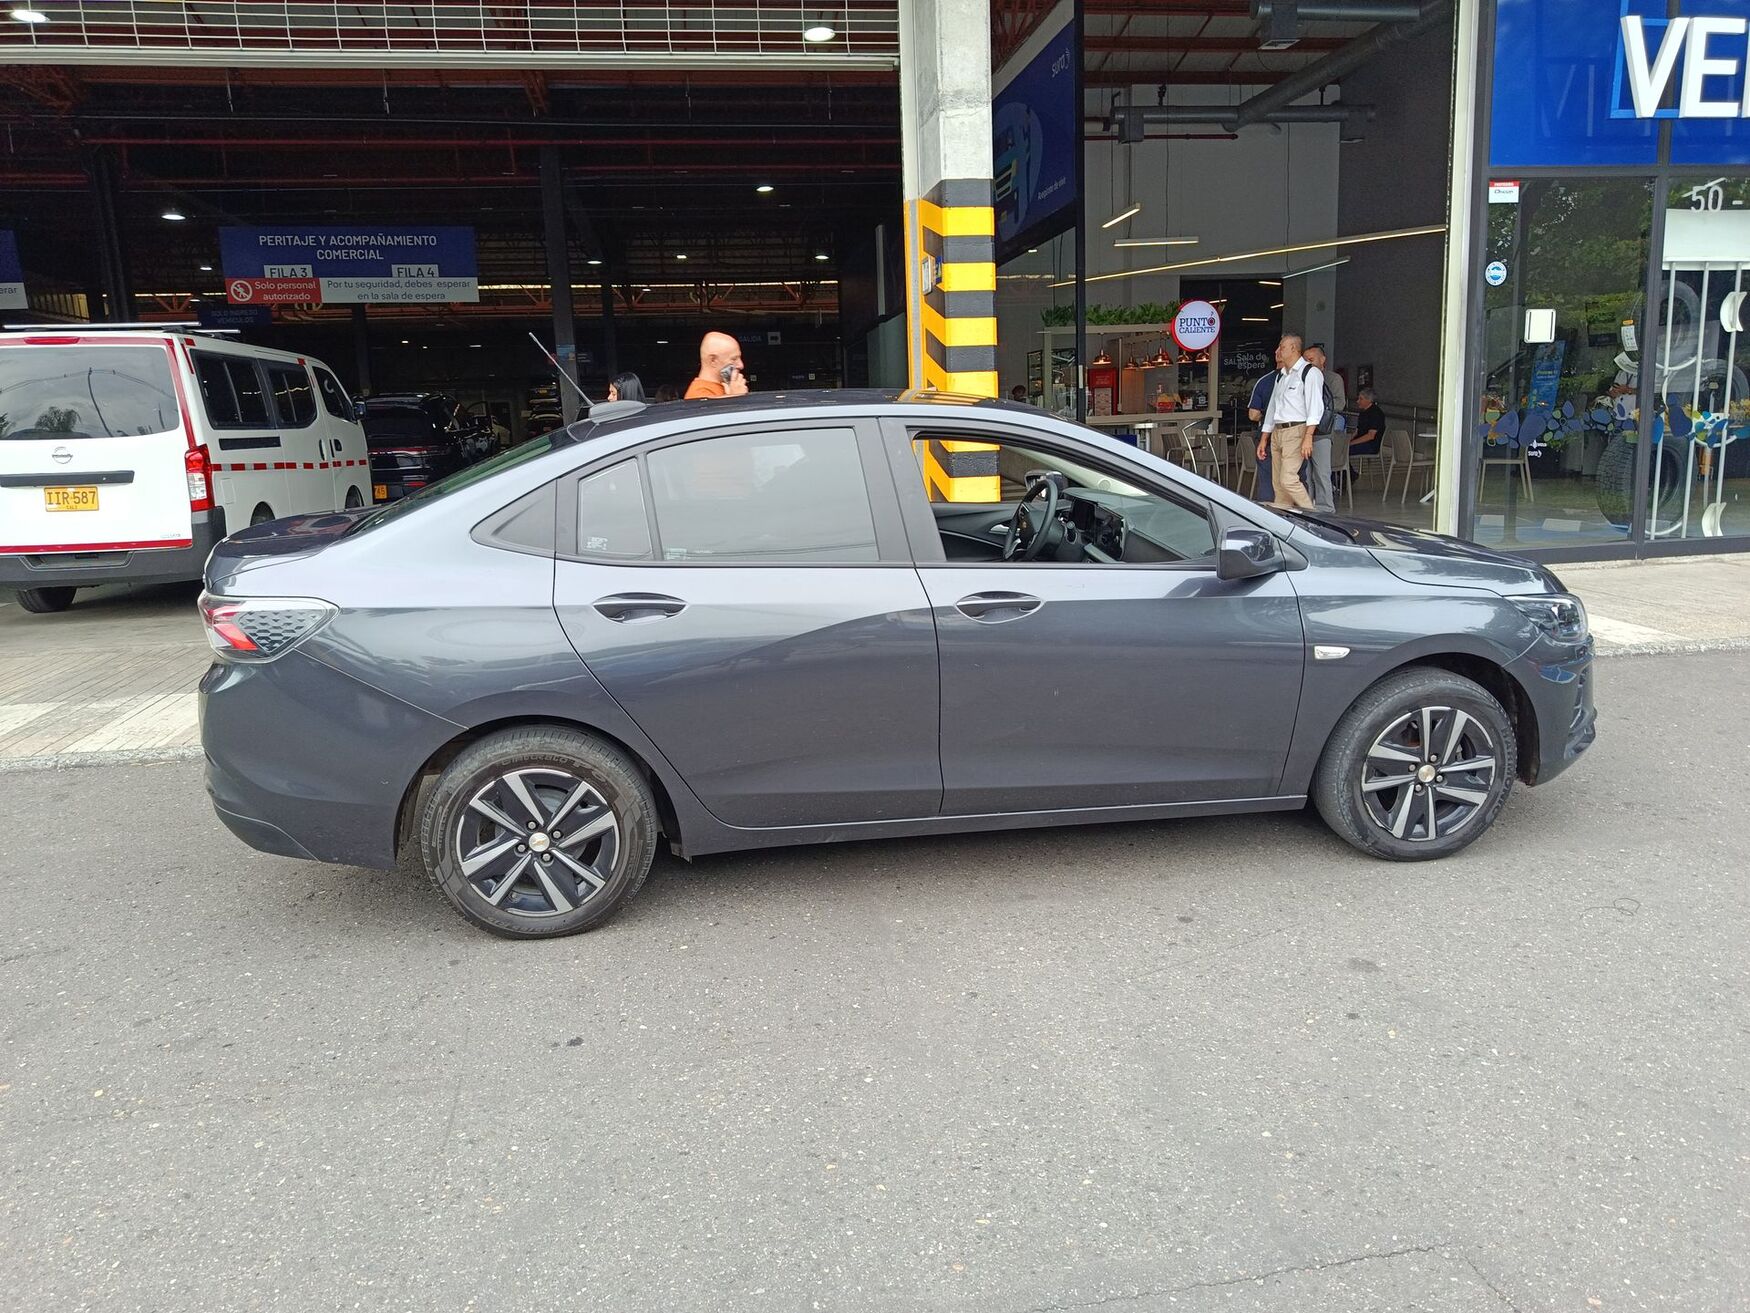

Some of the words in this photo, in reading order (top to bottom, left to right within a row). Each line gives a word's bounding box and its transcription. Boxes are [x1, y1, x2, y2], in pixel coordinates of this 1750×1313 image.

[1620, 15, 1750, 119] VE
[1691, 185, 1724, 213] 50
[259, 235, 317, 246] PERITAJE
[318, 235, 327, 246] Y
[329, 233, 437, 246] ACOMPAÑAMIENTO
[316, 249, 385, 260] COMERCIAL
[269, 267, 296, 278] FILA
[300, 267, 308, 278] 3
[396, 267, 425, 278] FILA
[427, 267, 435, 278] 4
[254, 281, 276, 290] Solo
[277, 281, 317, 292] personal
[327, 280, 343, 289] Por
[344, 281, 354, 289] tu
[355, 280, 403, 291] seguridad,
[404, 280, 433, 289] debes
[436, 281, 471, 291] esperar
[262, 292, 311, 301] autorizado
[371, 292, 380, 301] la
[381, 292, 400, 301] sala
[401, 292, 413, 301] de
[414, 293, 446, 303] espera
[1179, 317, 1216, 327] PUNTO
[1178, 326, 1216, 334] CALIENTE
